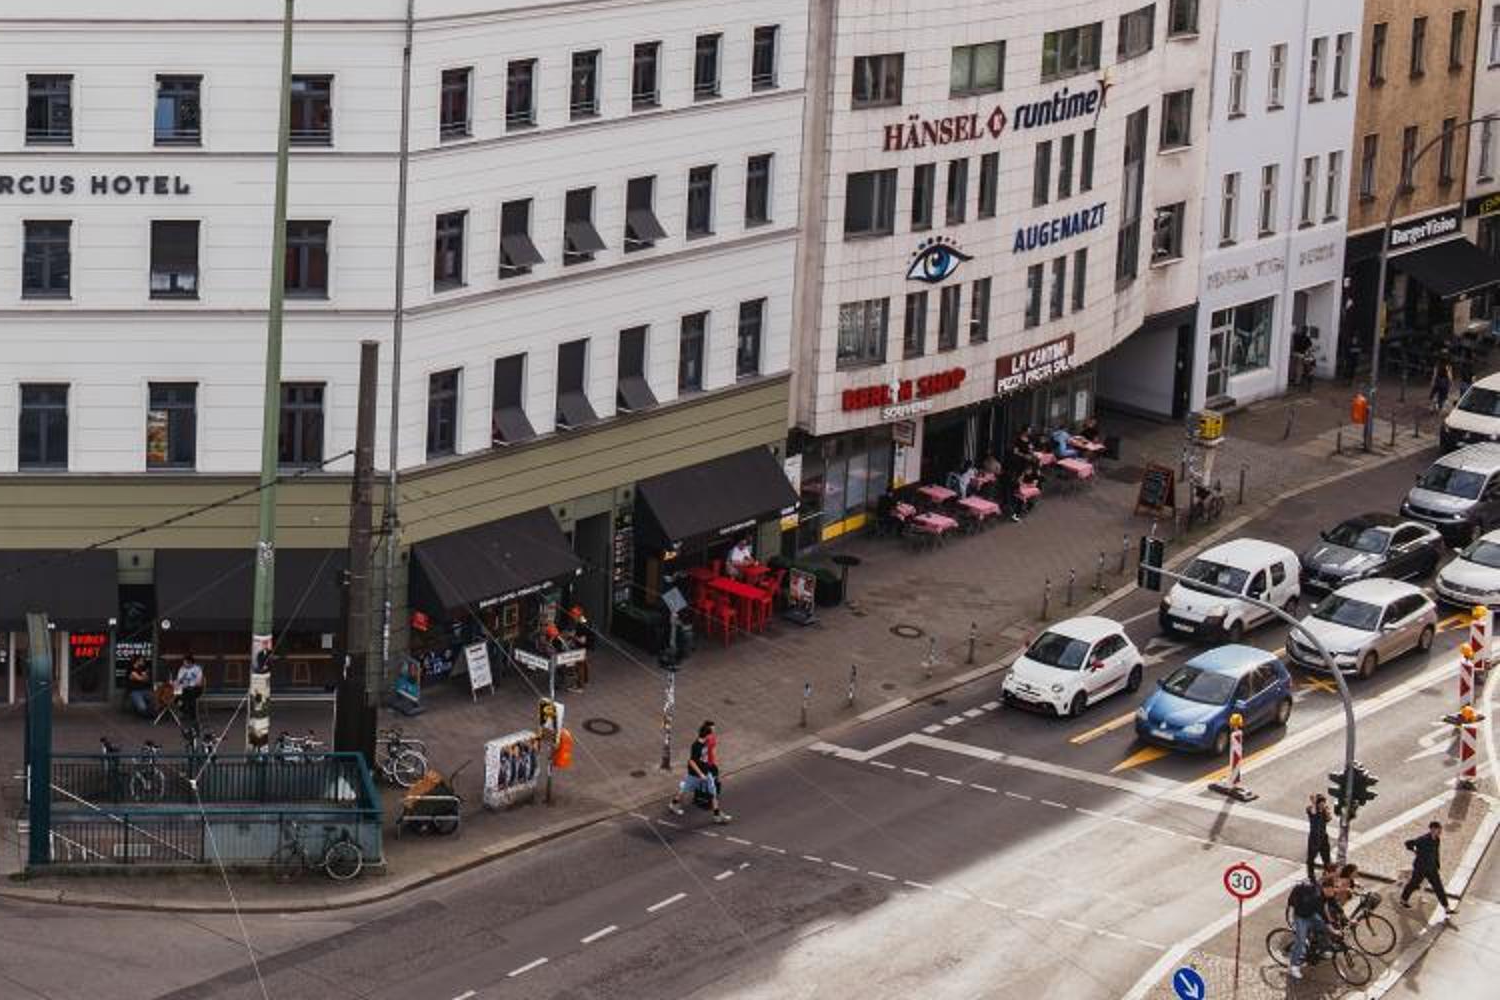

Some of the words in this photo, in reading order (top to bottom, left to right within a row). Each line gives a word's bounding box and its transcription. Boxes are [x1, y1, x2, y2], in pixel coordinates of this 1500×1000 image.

[1013, 87, 1098, 131] runtime
[882, 114, 984, 151] HÄNSEL
[90, 174, 190, 195] HOTEL
[1012, 202, 1107, 255] AUGENARZT
[916, 367, 966, 399] SHOP
[1231, 872, 1254, 891] 30
